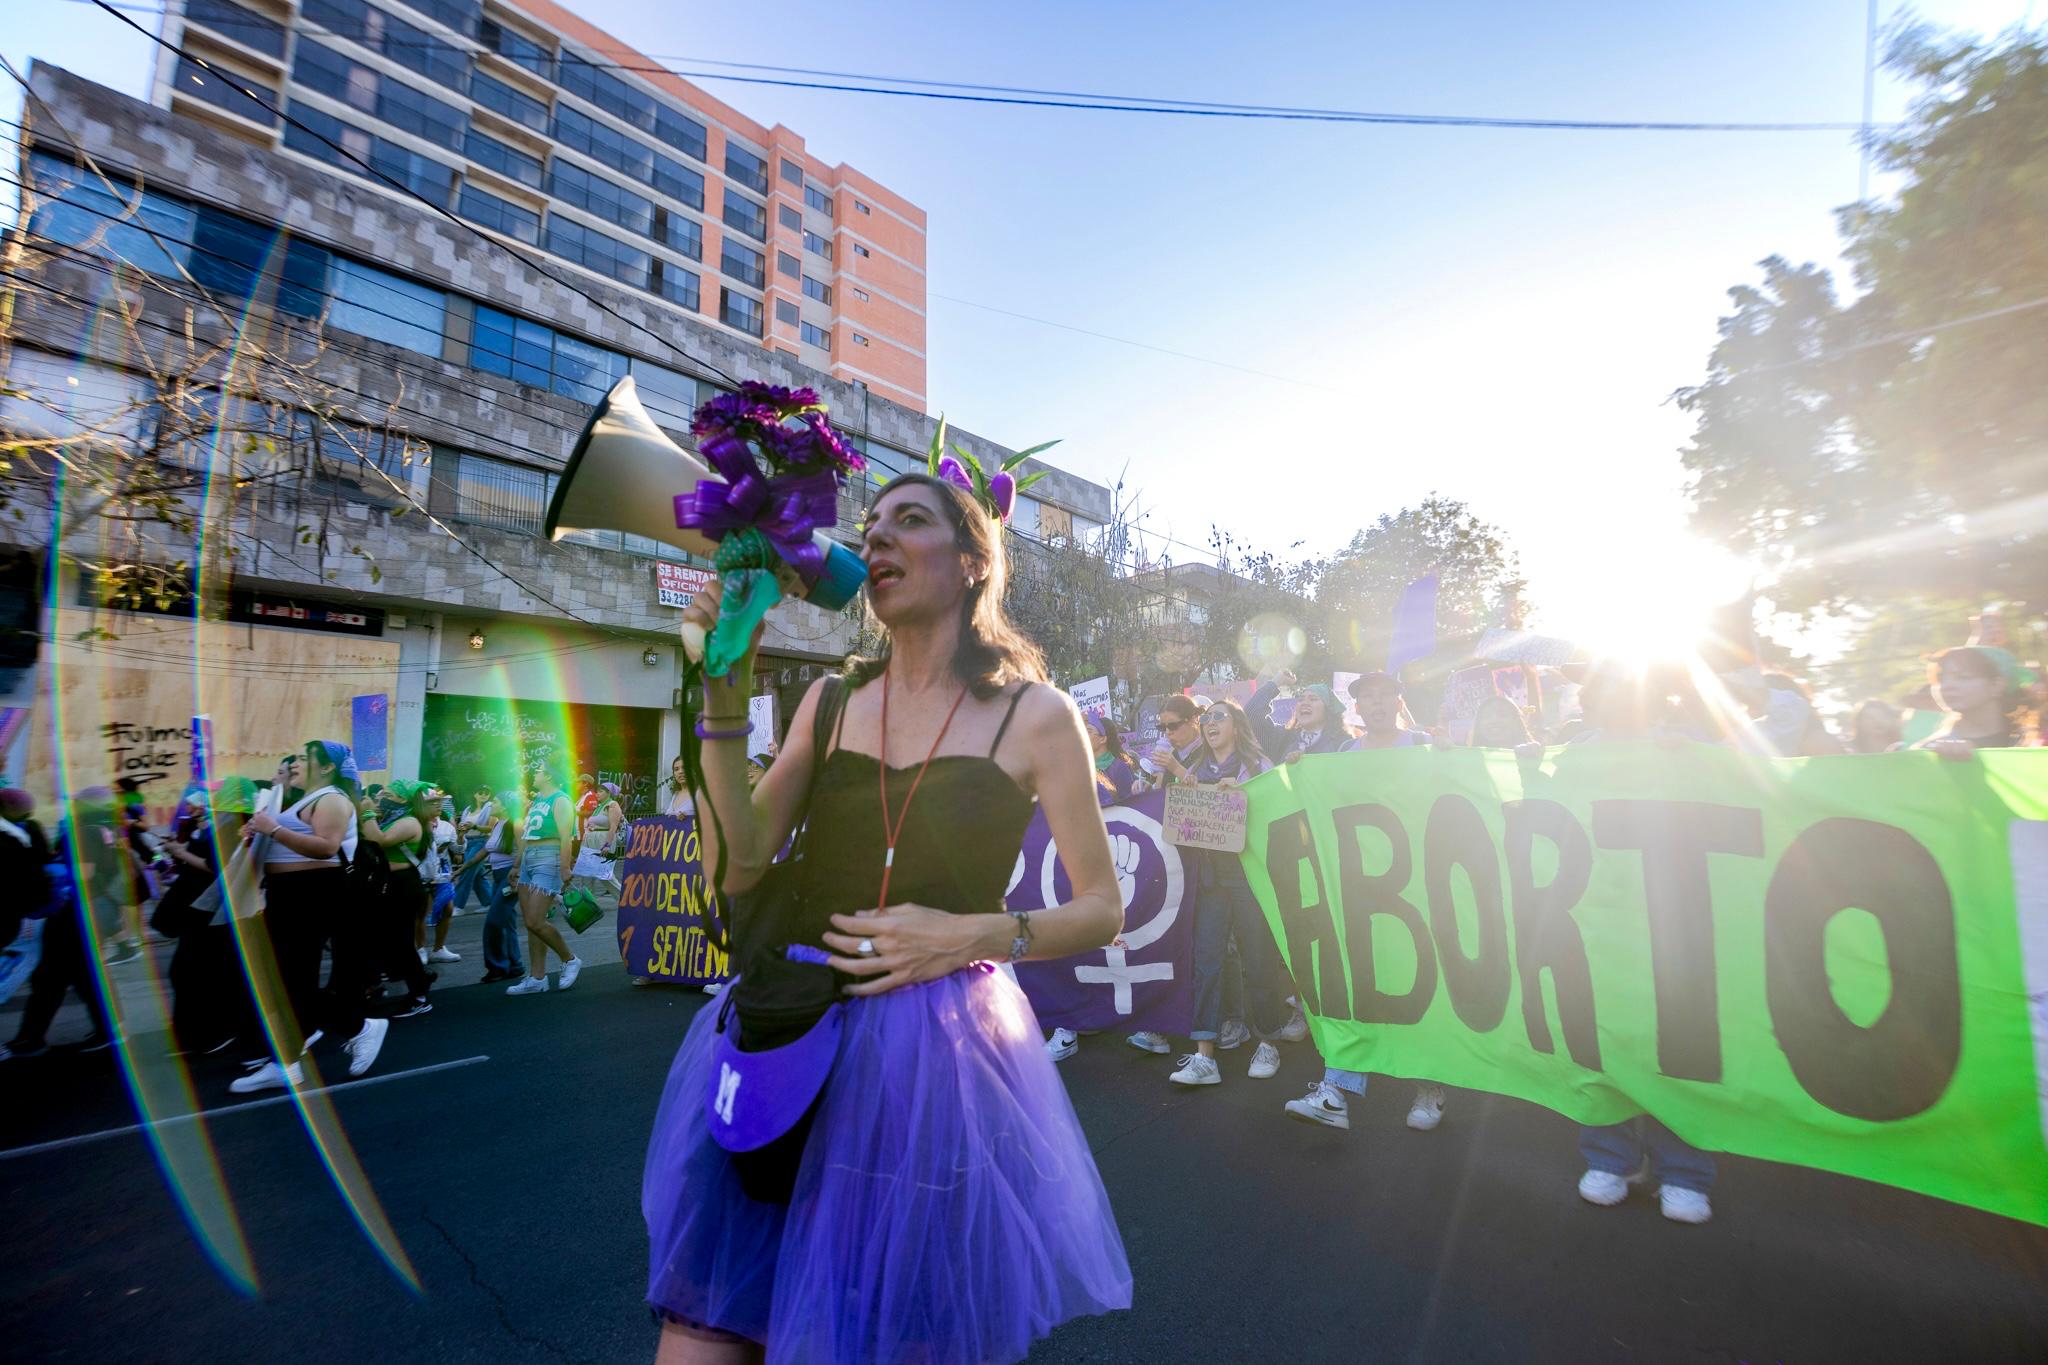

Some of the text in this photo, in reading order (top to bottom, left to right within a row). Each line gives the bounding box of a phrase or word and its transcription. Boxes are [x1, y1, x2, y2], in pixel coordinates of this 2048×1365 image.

[658, 563, 717, 583] SE RENTAN
[661, 578, 704, 592] OFICIN
[1073, 689, 1087, 699] Nos
[1077, 690, 1108, 710] queremos
[465, 709, 496, 724] Las
[626, 823, 664, 859] 1000
[619, 872, 655, 908] 100
[620, 925, 635, 970] 1
[1266, 795, 1963, 1123] ABORTO
